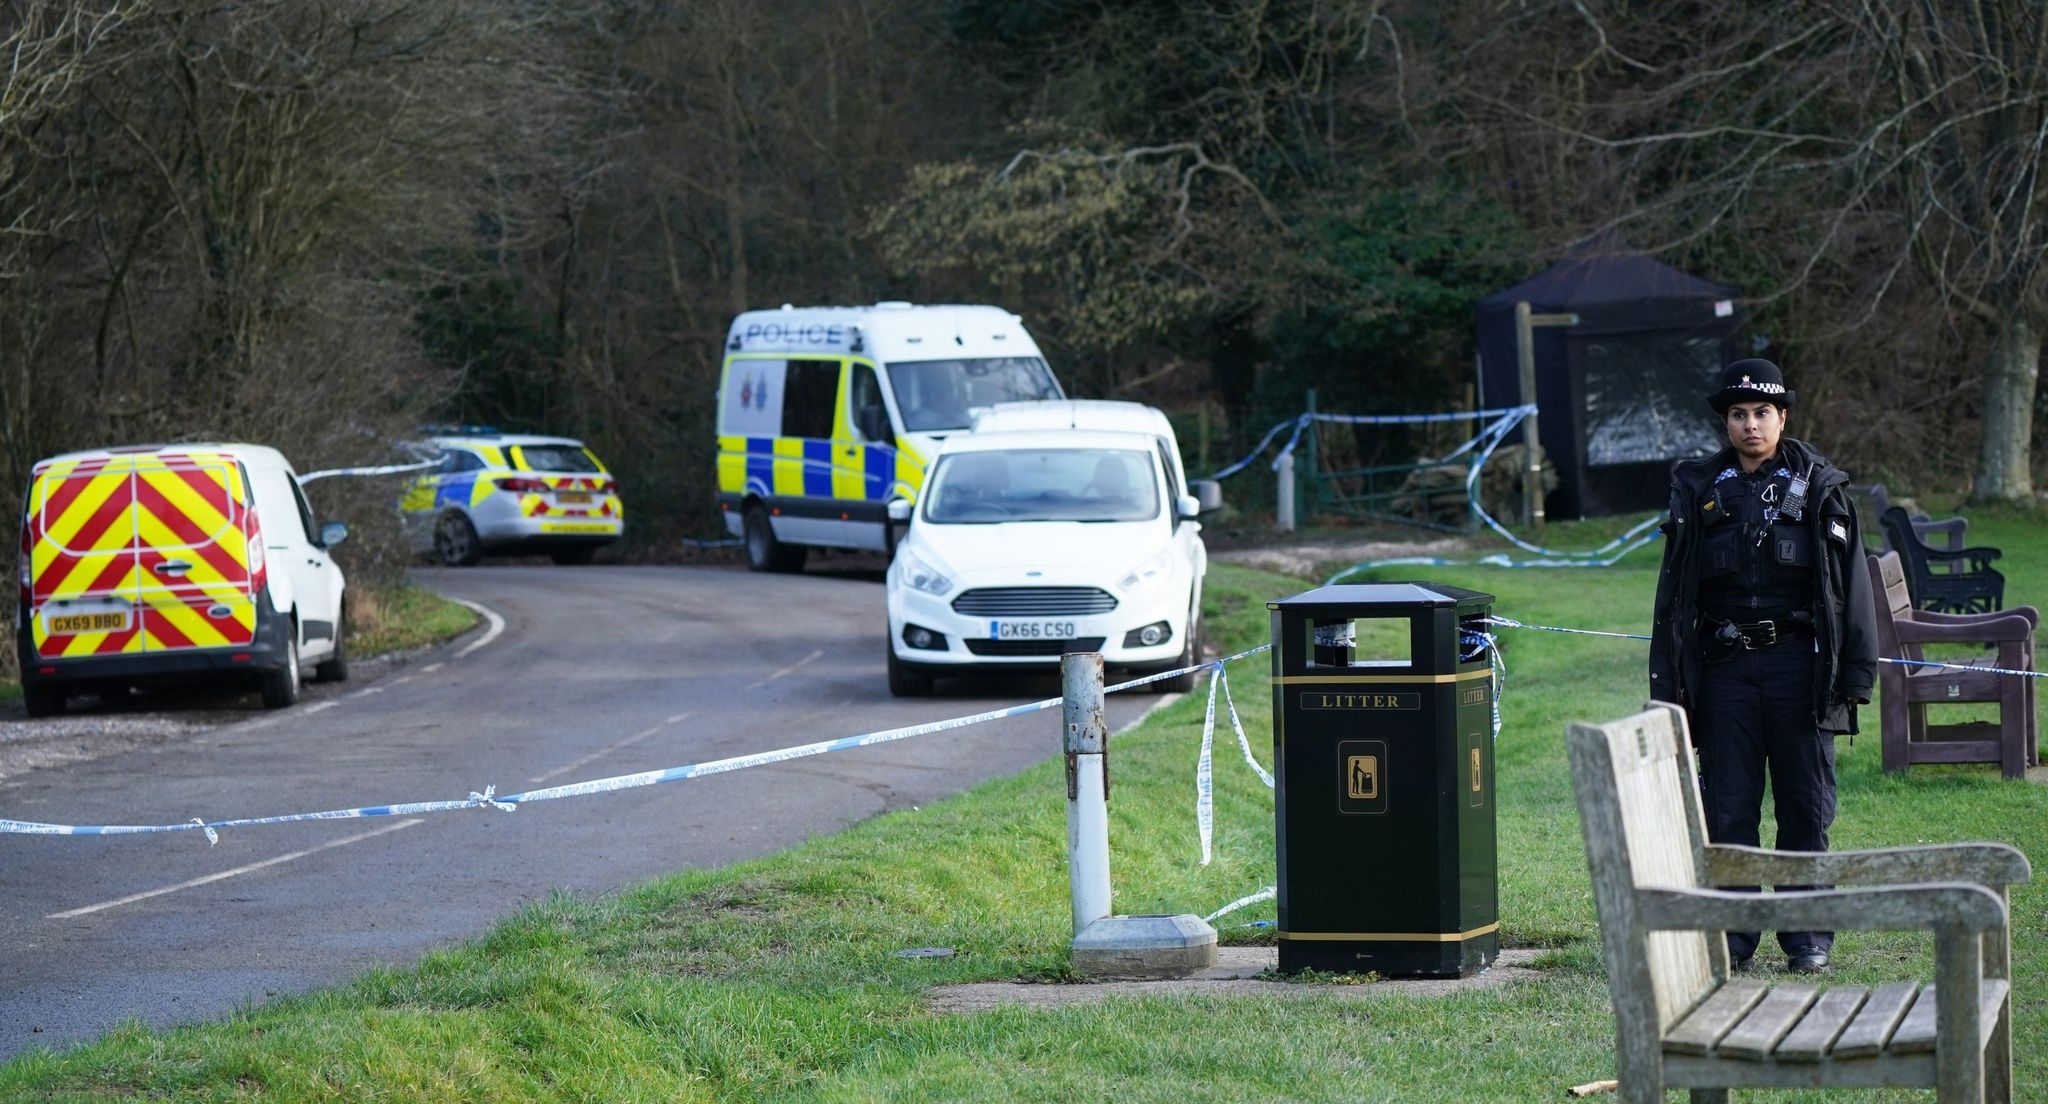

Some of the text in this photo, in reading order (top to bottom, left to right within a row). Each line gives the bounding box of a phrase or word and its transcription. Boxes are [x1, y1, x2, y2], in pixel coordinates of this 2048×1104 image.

[745, 323, 842, 345] POLICE
[54, 614, 90, 632] GX69
[1000, 622, 1040, 637] GX66
[1321, 694, 1399, 708] LITTER
[1463, 689, 1484, 704] LITTER
